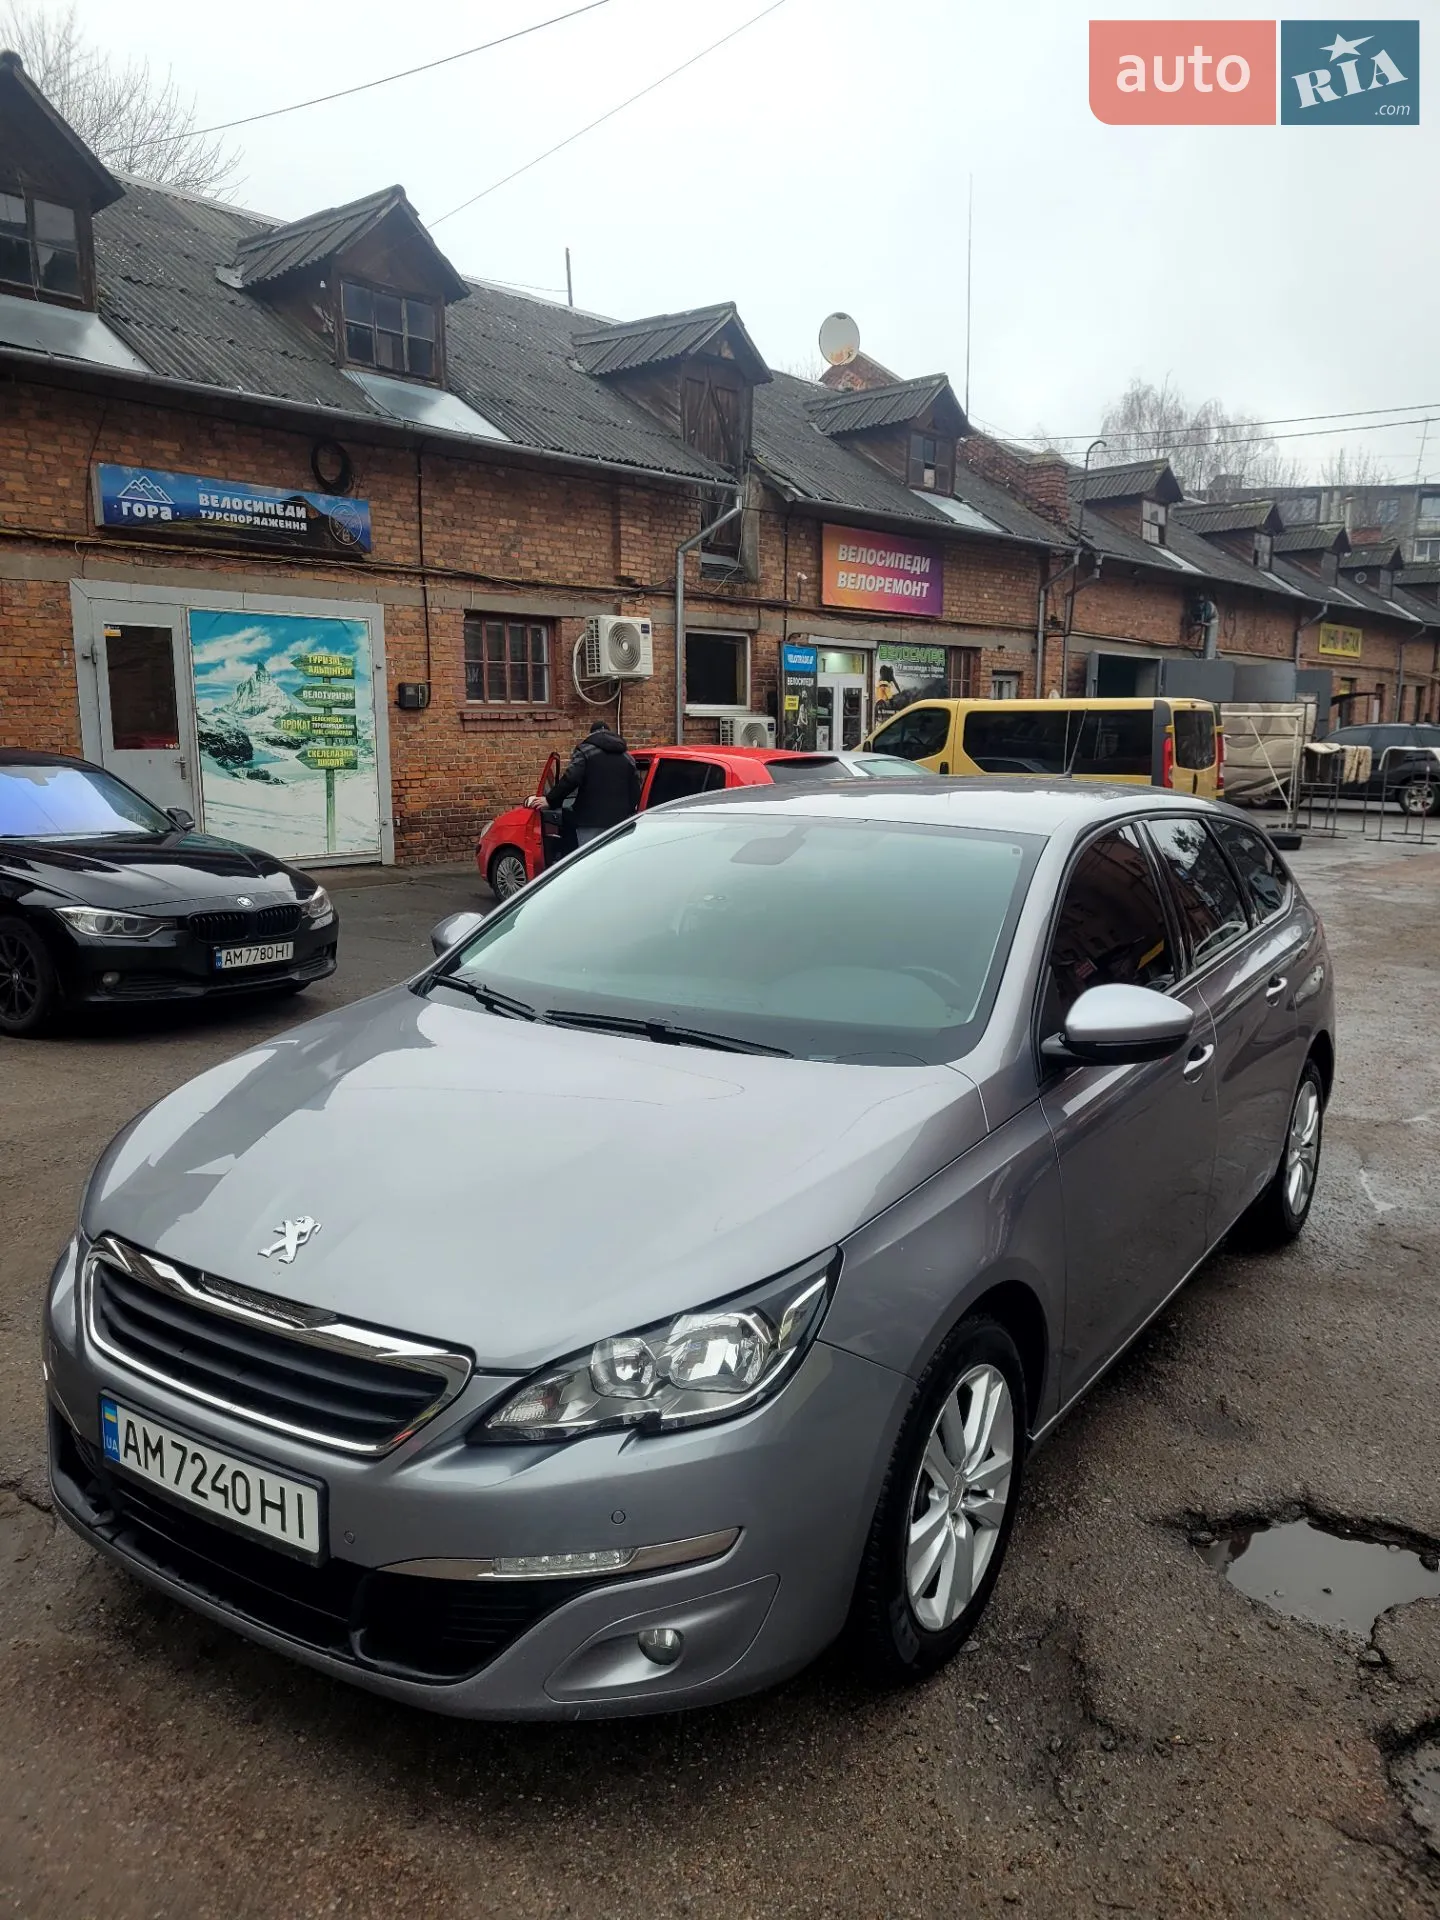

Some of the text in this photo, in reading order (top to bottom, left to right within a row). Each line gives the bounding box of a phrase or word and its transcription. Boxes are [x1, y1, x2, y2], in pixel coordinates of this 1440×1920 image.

[199, 493, 307, 519] ВЕЛОСИПЕДИ
[199, 509, 307, 532] ТУРСПОРЯДЖЕННЯ
[838, 544, 931, 574] ВЕЛОСИПЕДИ
[837, 571, 930, 598] ВЕЛОРЕМОНТ
[303, 690, 353, 701] ВЕЛОТУРИЗМ
[281, 719, 311, 730] ПРОКАТ
[307, 749, 353, 758] СКЕЛЕЛАЗНА
[317, 758, 345, 767] ШКОЛА
[224, 943, 289, 966] AM7780HI
[106, 1435, 119, 1453] UA
[123, 1419, 305, 1540] AM7240HI
